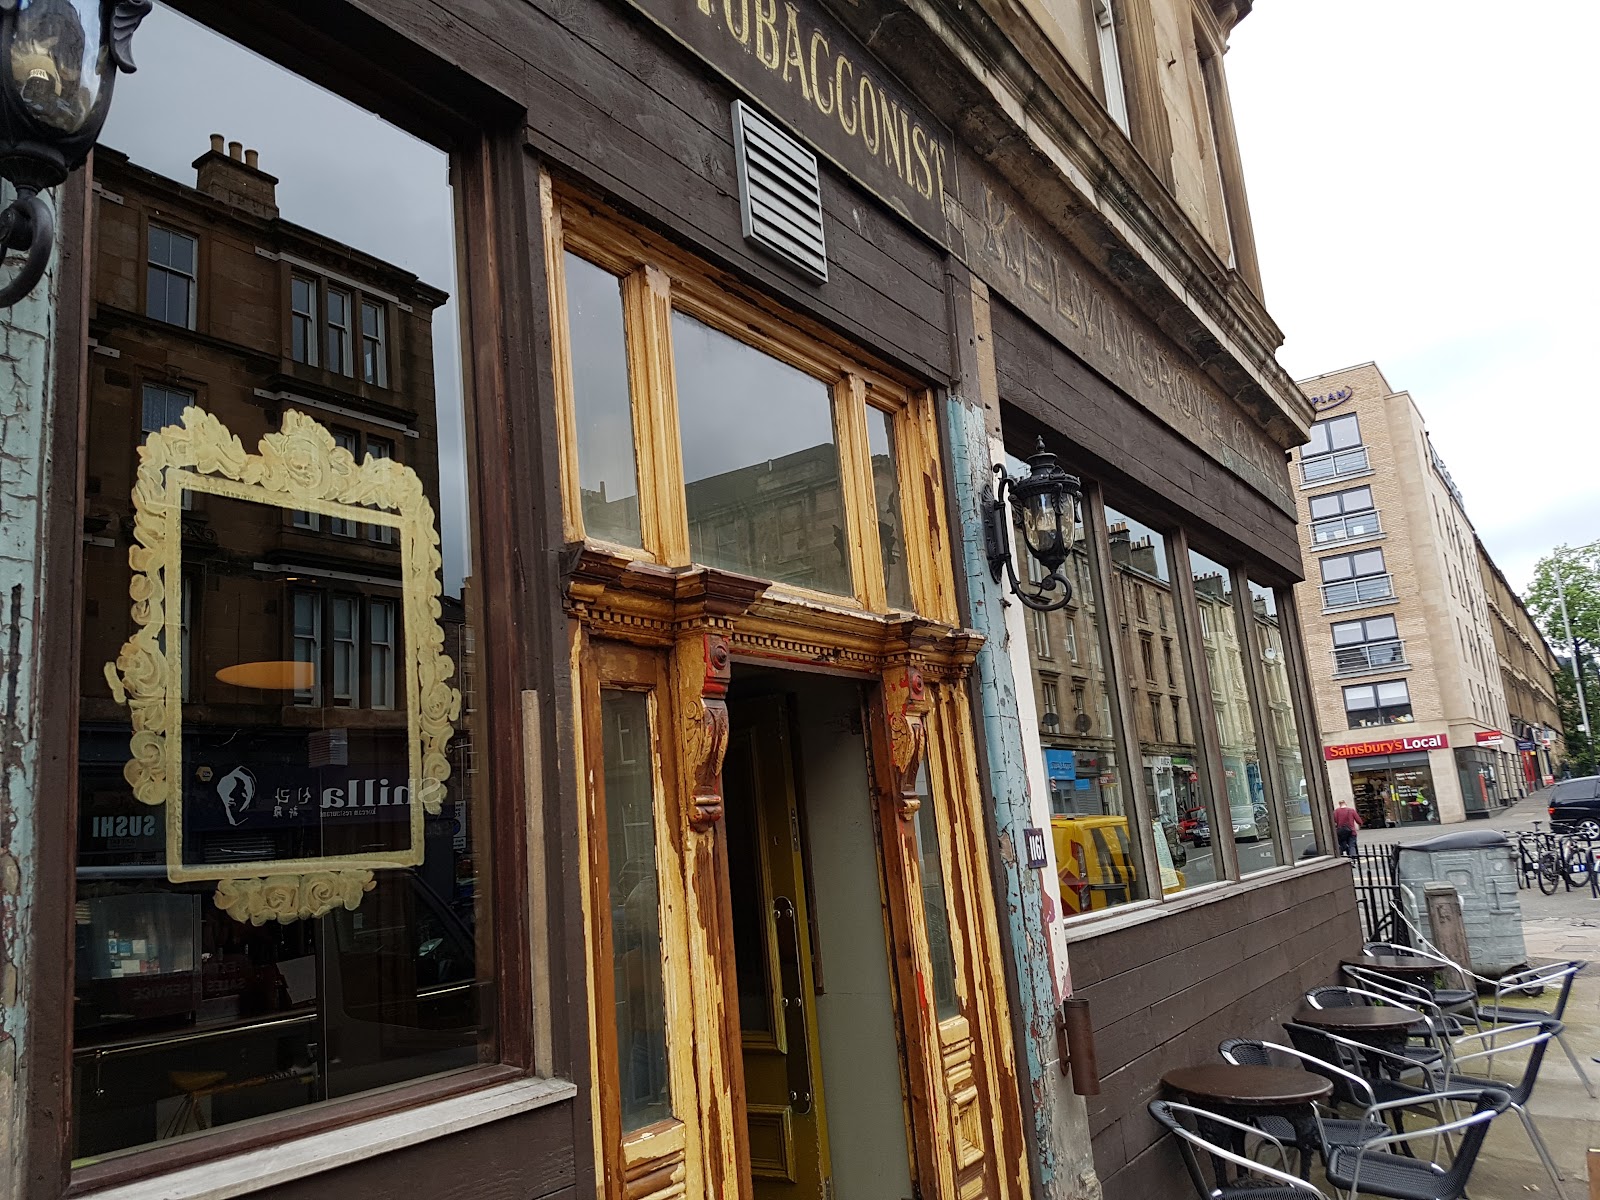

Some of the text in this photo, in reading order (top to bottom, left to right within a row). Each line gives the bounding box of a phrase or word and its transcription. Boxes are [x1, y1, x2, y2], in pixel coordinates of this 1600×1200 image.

[697, 0, 947, 214] OBACCONIST
[979, 176, 1226, 443] KELVINGROVE
[1330, 735, 1442, 757] Sainsbury's Local
[1028, 834, 1045, 861] 1161
